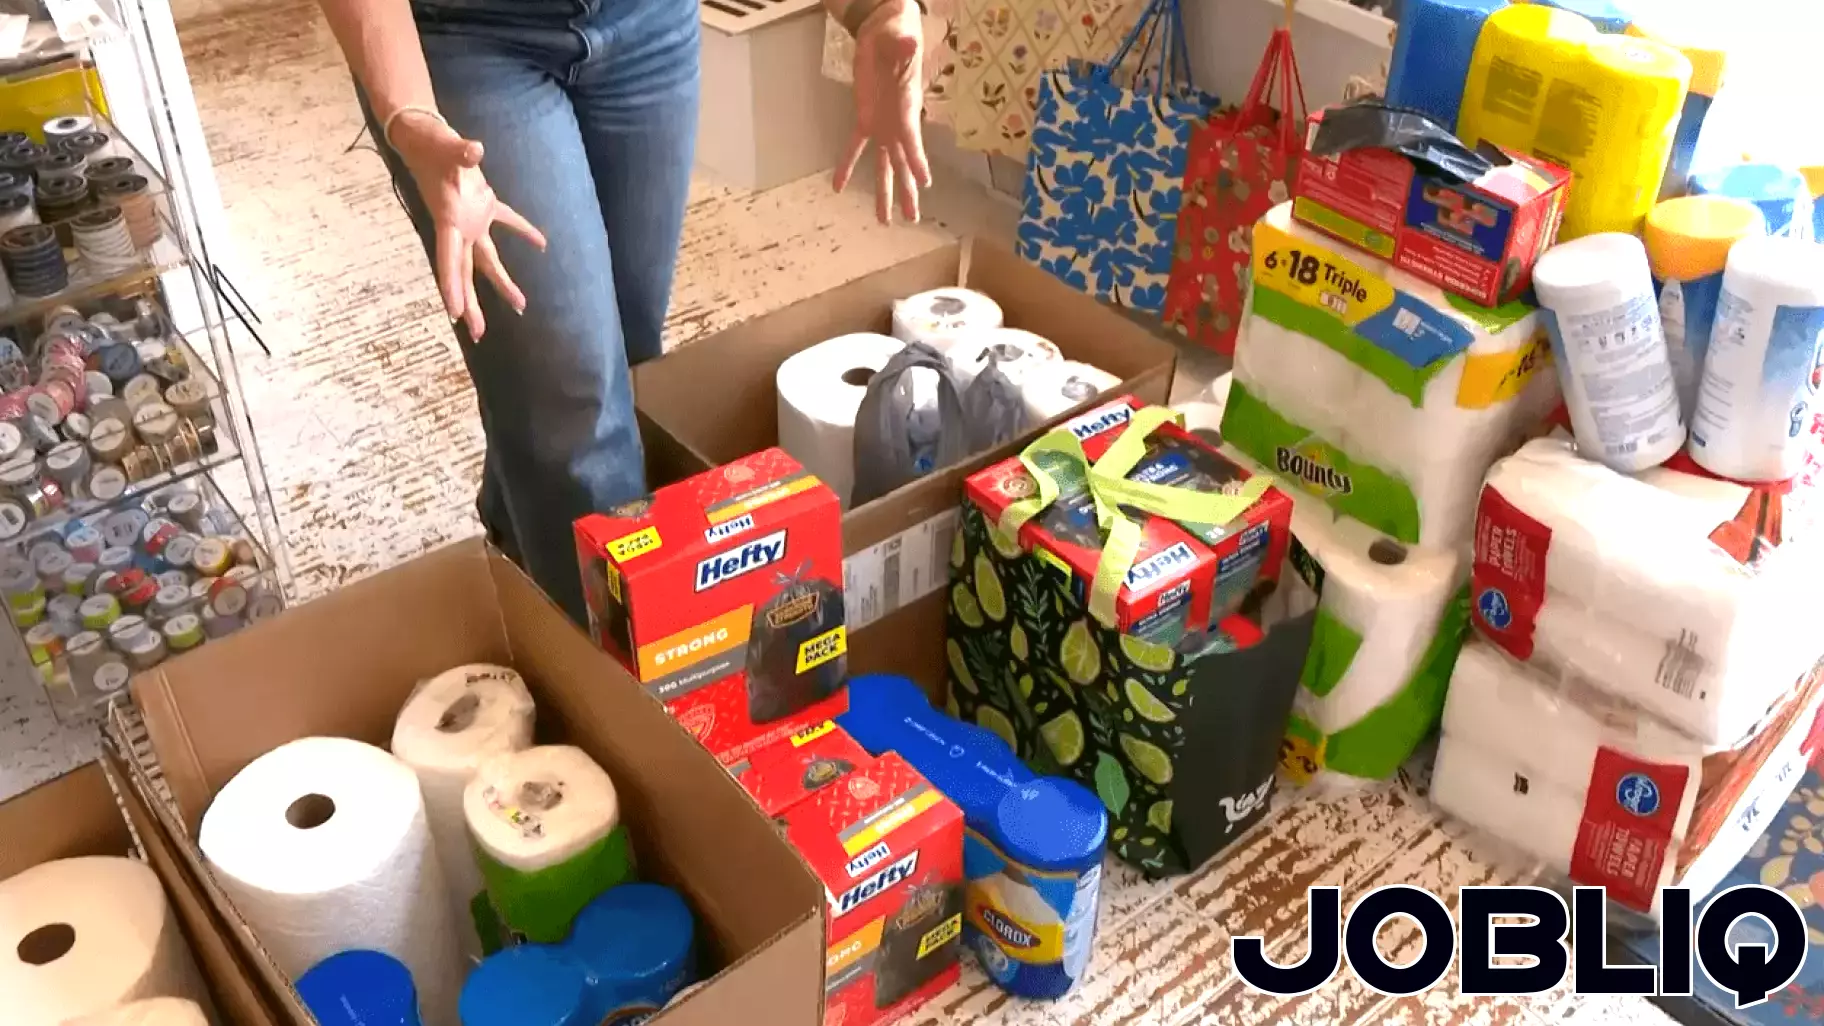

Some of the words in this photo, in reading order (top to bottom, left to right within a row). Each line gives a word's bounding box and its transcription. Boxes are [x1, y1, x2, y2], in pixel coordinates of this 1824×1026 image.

[1264, 250, 1278, 270] 6
[1288, 250, 1320, 286] 18
[1324, 262, 1368, 304] Triple
[1072, 408, 1131, 438] Hefty
[699, 539, 782, 586] Hefty
[654, 627, 730, 667] STRONG
[840, 859, 914, 911] Hefty
[983, 908, 1033, 949] CLOROX
